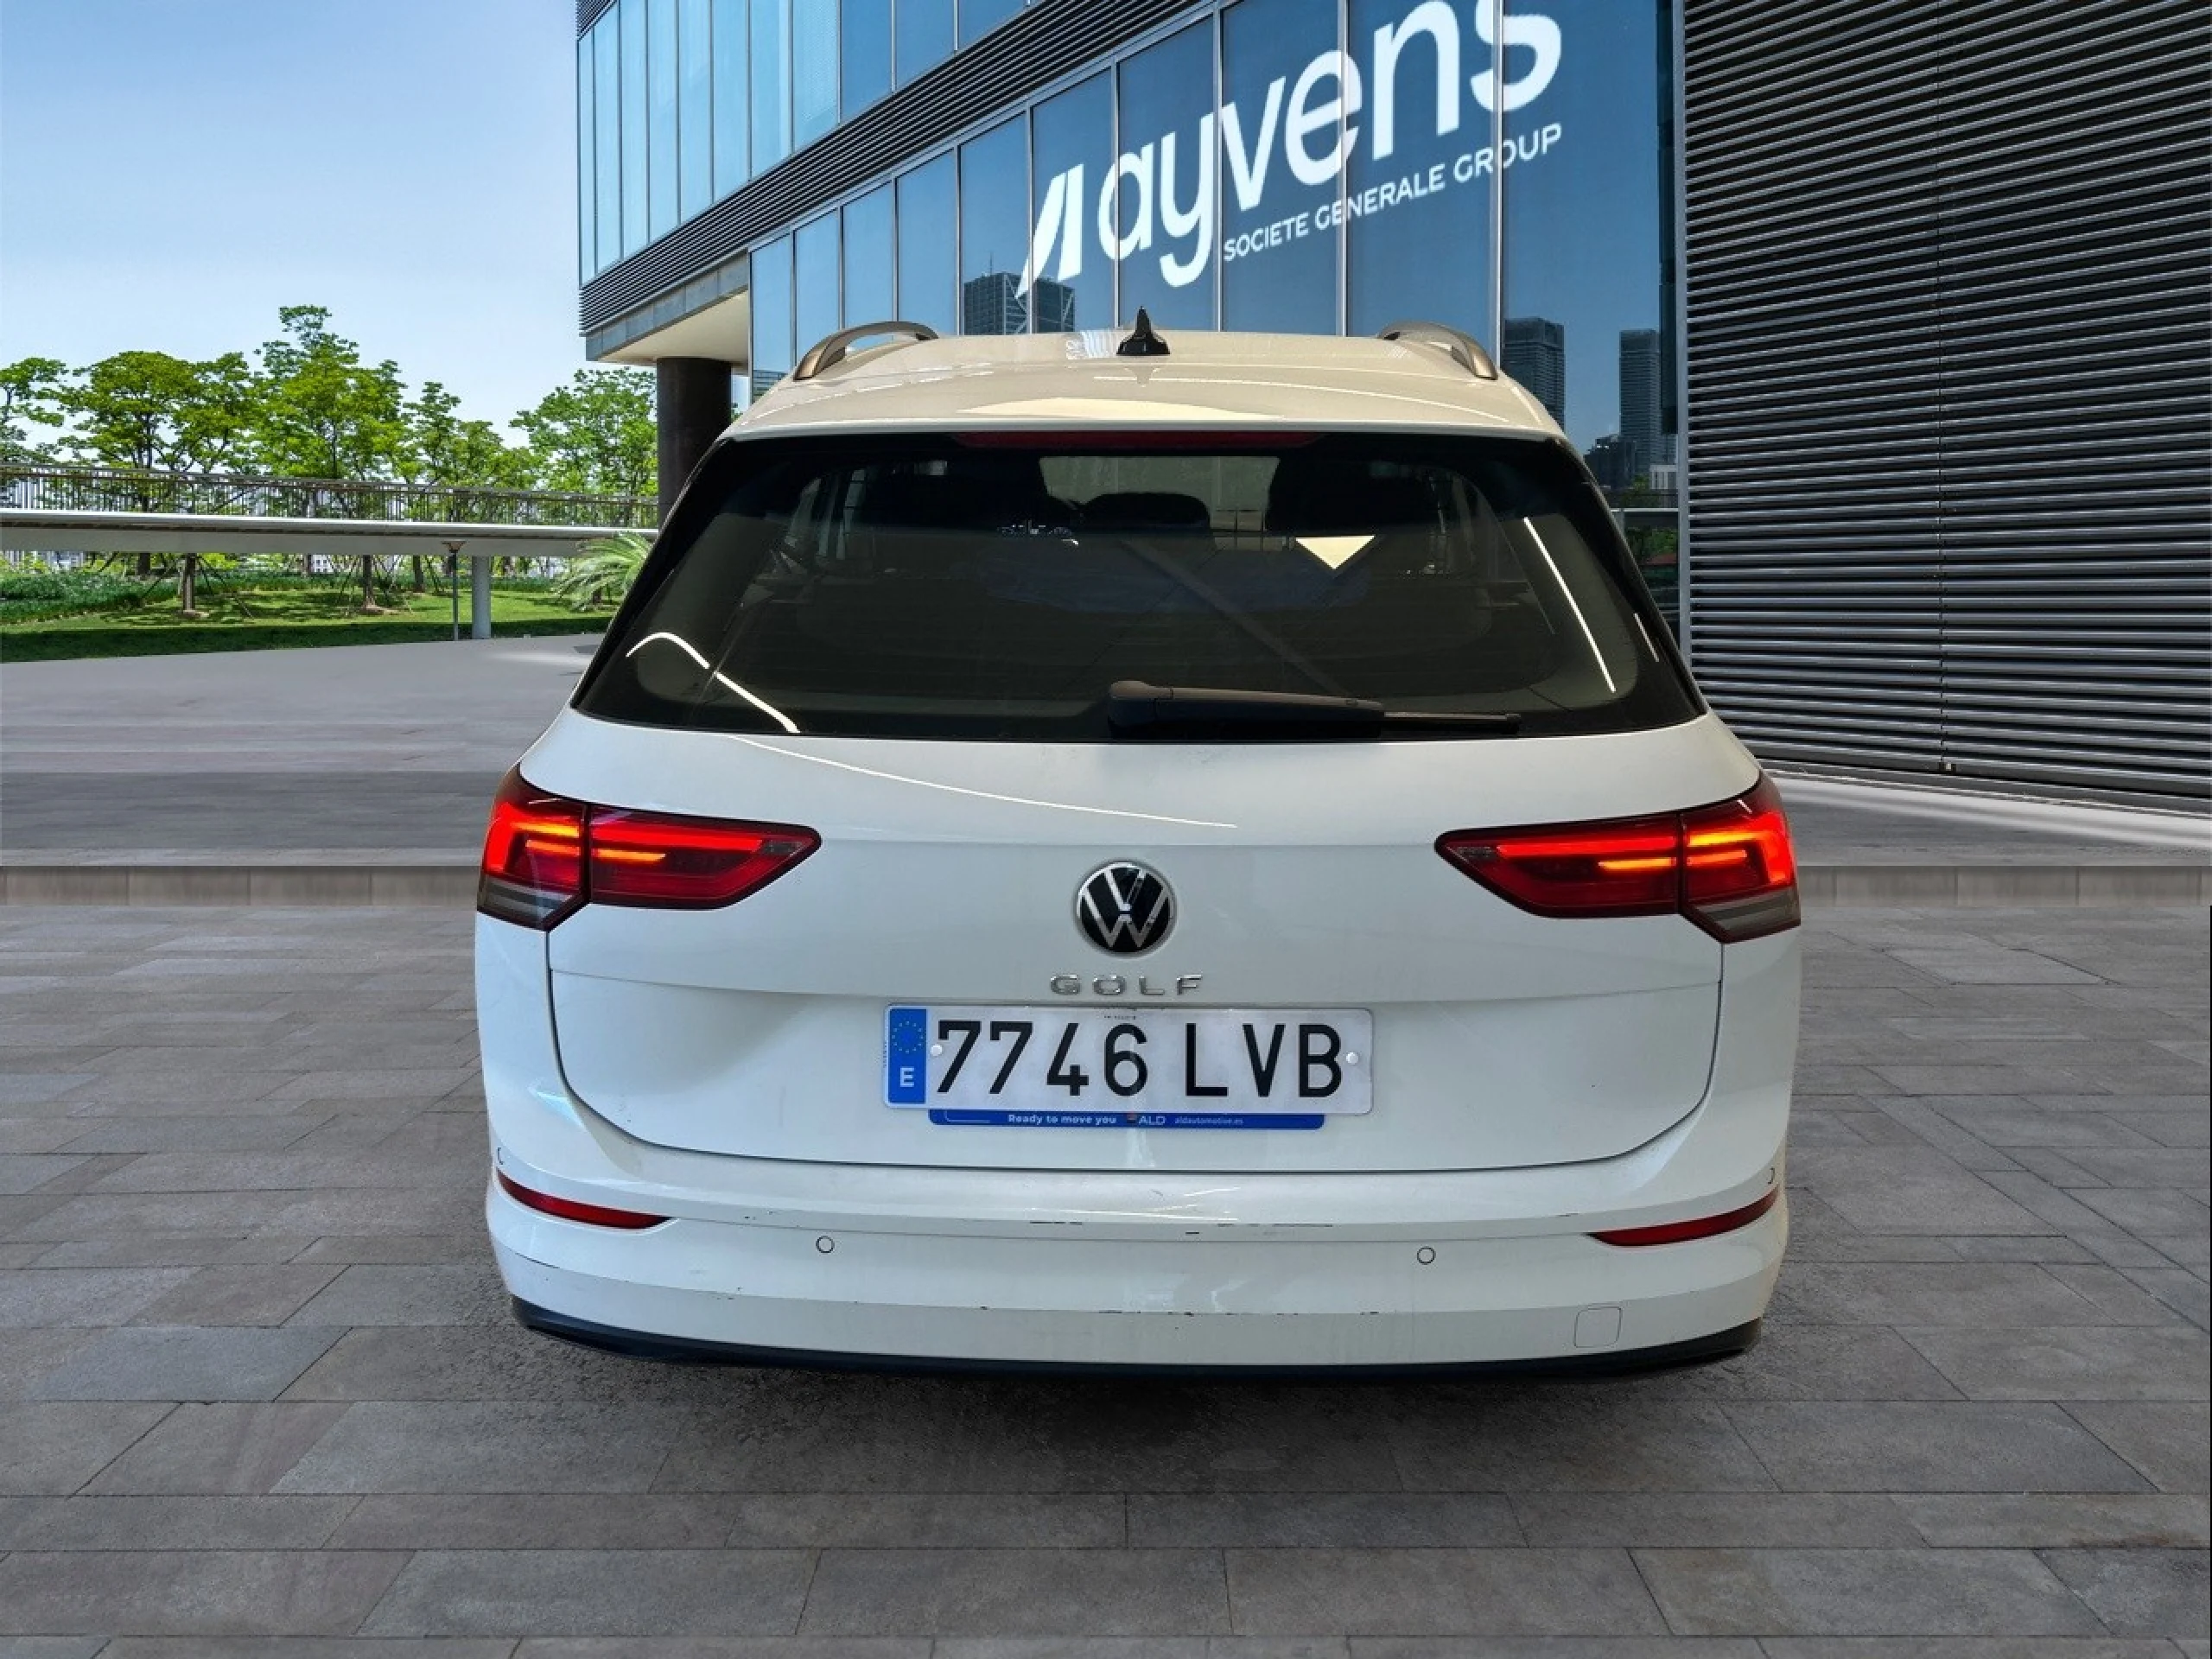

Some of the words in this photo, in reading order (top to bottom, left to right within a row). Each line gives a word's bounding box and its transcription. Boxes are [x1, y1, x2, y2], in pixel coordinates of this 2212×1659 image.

[1097, 0, 1561, 287] ayvens
[1224, 212, 1308, 261] SOCIETE
[1315, 164, 1446, 226] GENERALE
[1454, 123, 1561, 183] GROUP
[1050, 974, 1203, 995] GOLF
[938, 1020, 1148, 1097] 7746
[1185, 1022, 1343, 1098] LVB
[899, 1066, 915, 1088] E
[1008, 1114, 1042, 1126] Ready
[1061, 1116, 1093, 1124] move
[1096, 1116, 1117, 1126] you
[1139, 1116, 1166, 1126] ALD
[1175, 1116, 1244, 1126] aldautomotive.es
